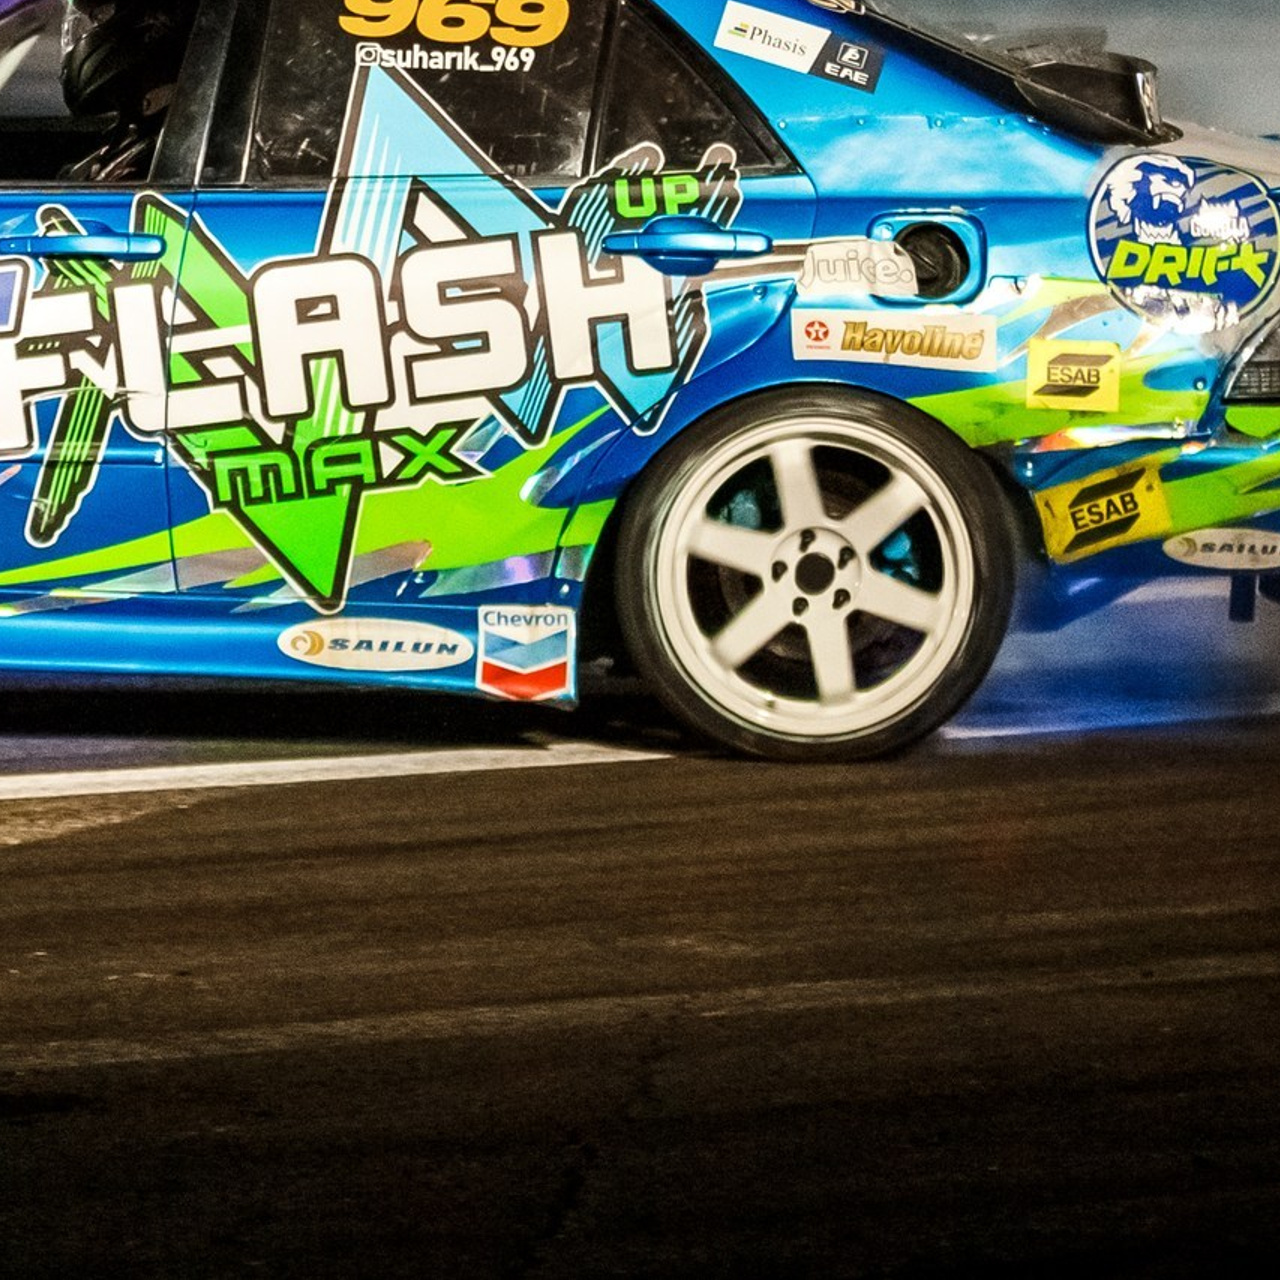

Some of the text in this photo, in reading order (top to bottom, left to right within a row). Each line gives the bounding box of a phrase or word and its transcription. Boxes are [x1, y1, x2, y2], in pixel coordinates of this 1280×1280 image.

[749, 25, 808, 57] Phasis
[824, 62, 870, 85] EAE
[614, 174, 700, 218] UP
[1106, 239, 1270, 289] DRIFT
[1047, 366, 1101, 385] ESAB
[1070, 491, 1140, 531] ESAB
[1200, 542, 1280, 555] SAILU
[483, 610, 569, 627] Chevron
[328, 638, 460, 656] SAILUN
